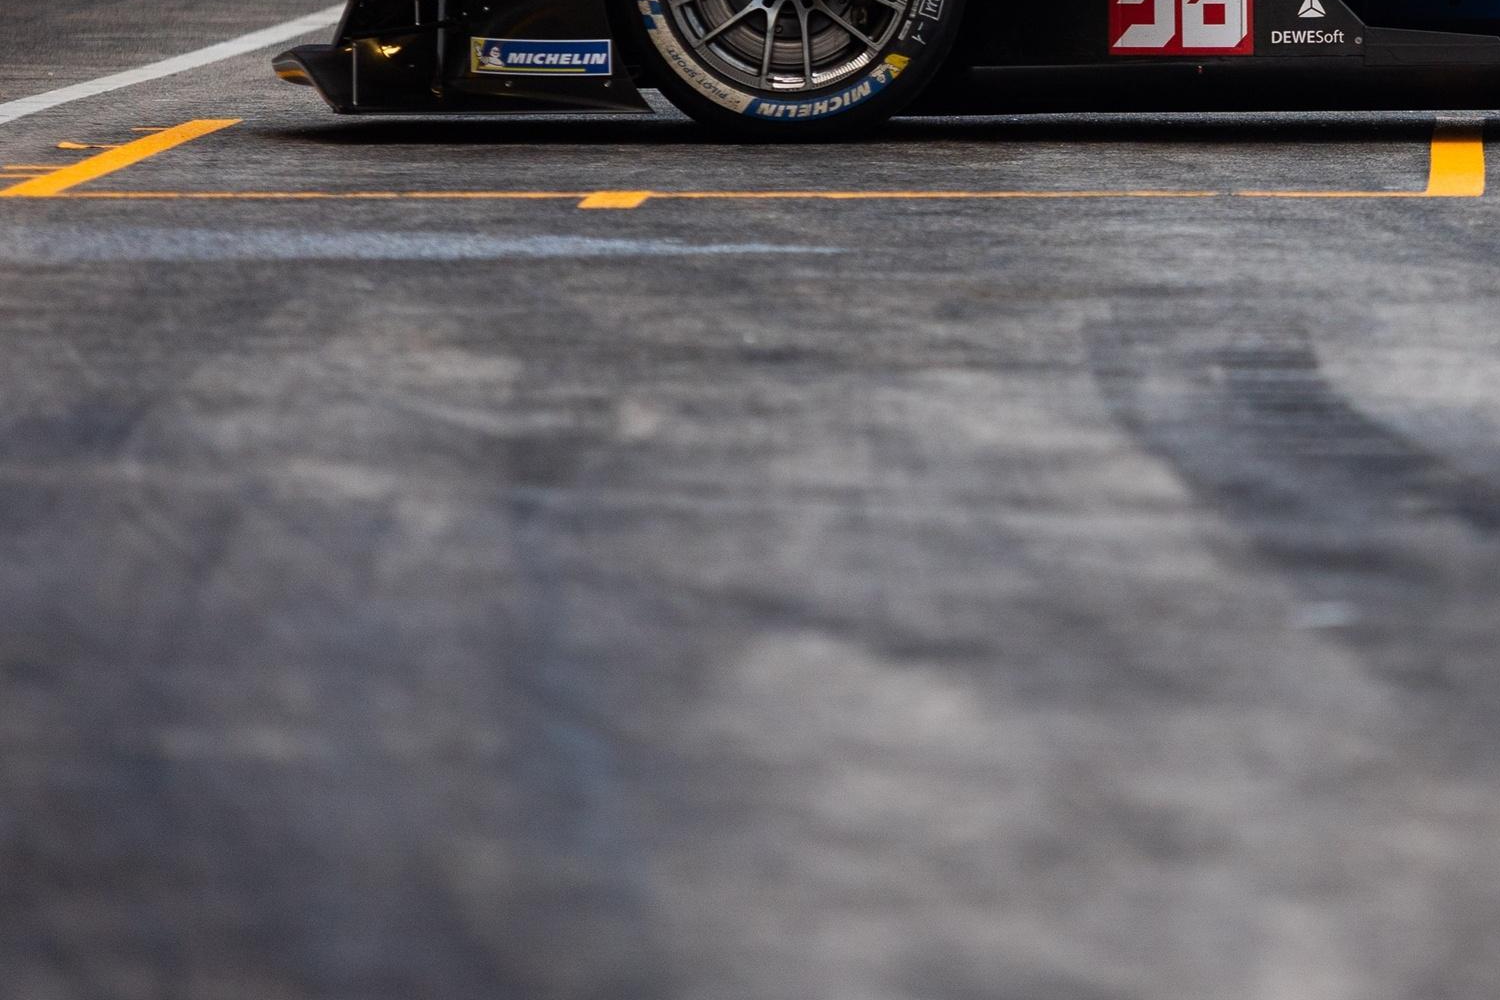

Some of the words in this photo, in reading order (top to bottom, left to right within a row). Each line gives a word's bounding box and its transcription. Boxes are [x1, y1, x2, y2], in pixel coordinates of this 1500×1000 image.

[1271, 30, 1344, 44] DEWESoft
[507, 52, 607, 65] MICHELIN
[756, 81, 871, 118] MICHELIN
